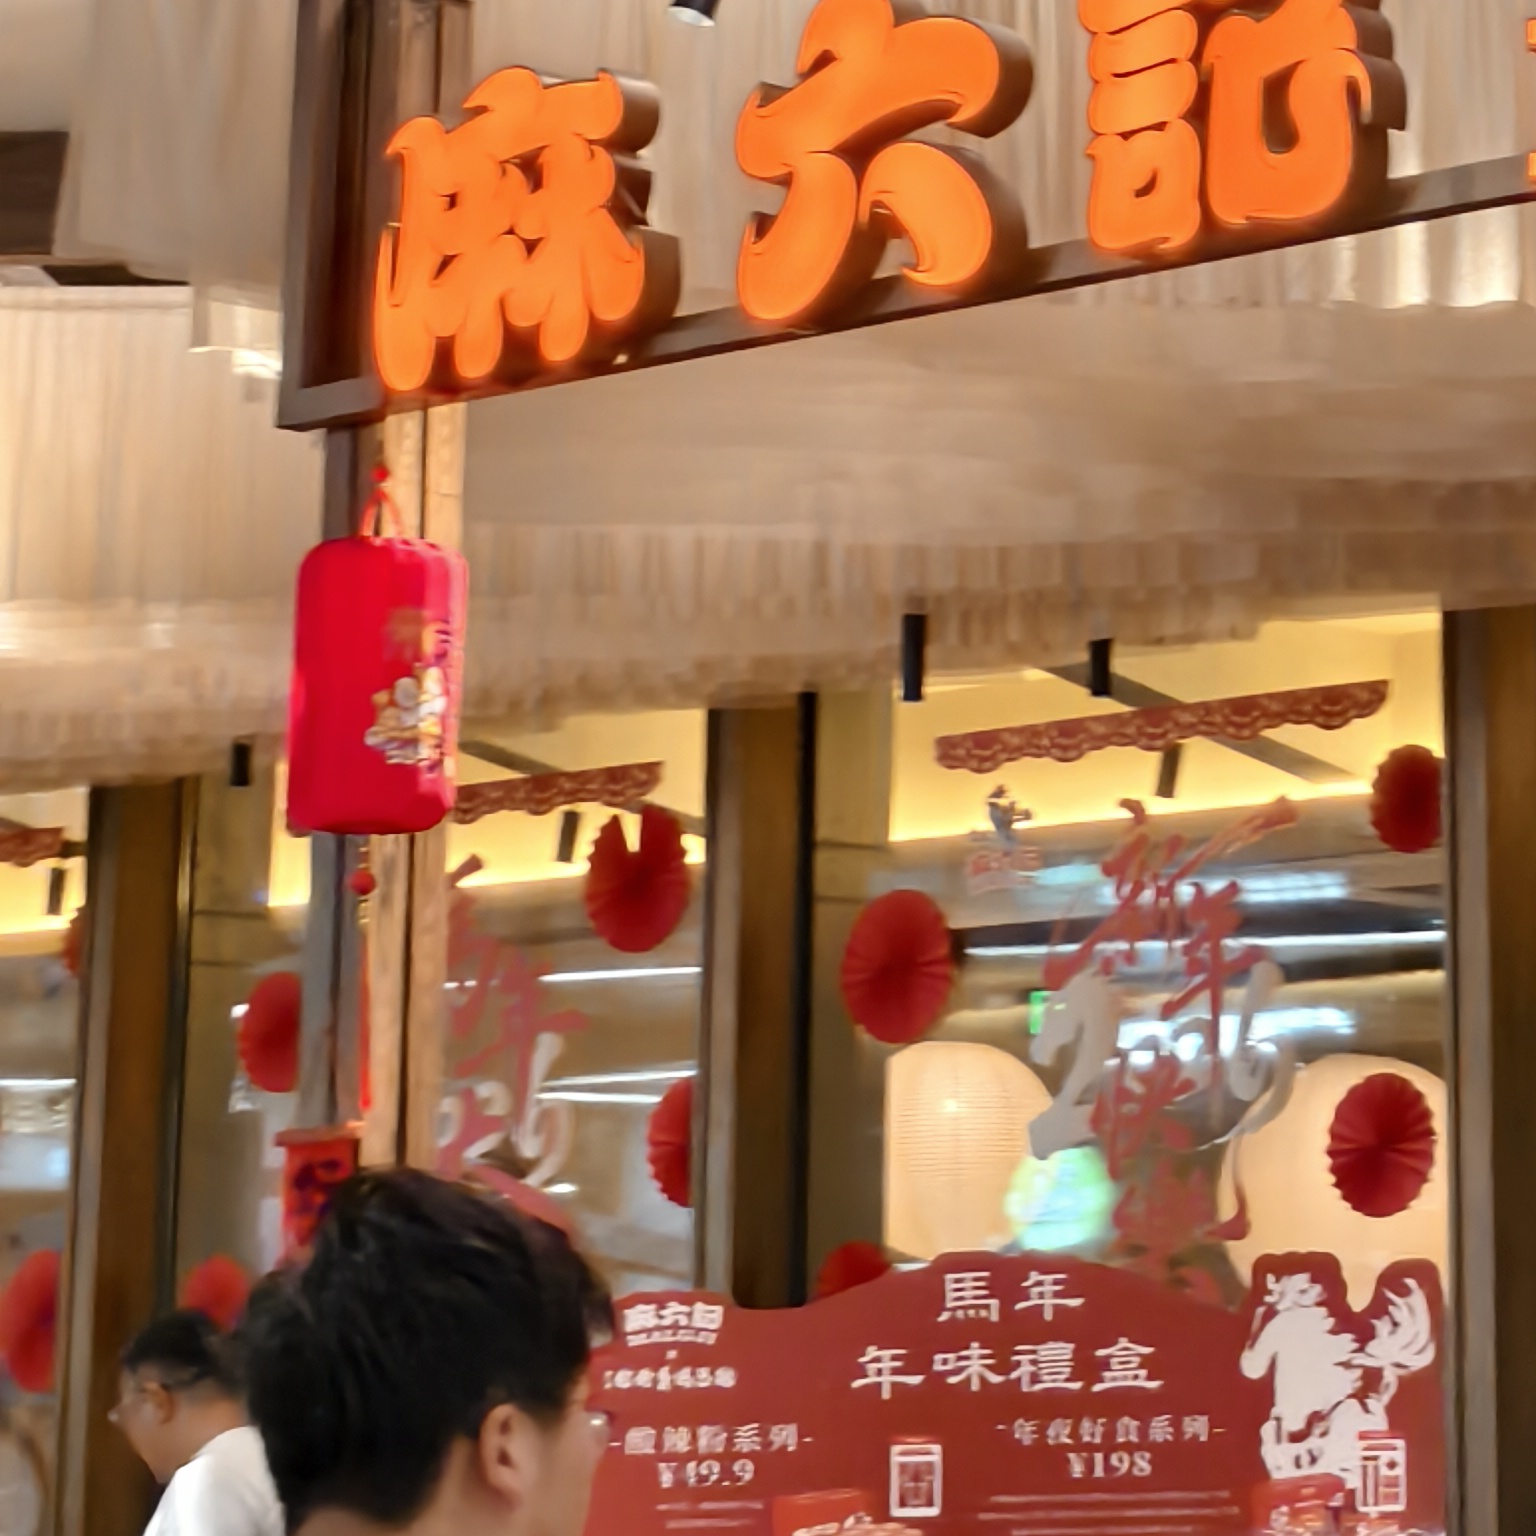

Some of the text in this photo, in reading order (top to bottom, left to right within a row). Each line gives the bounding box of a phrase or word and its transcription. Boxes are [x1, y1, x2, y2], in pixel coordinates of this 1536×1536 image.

[936, 1270, 1086, 1323] 馬年
[850, 1336, 1166, 1401] 年味禮盒
